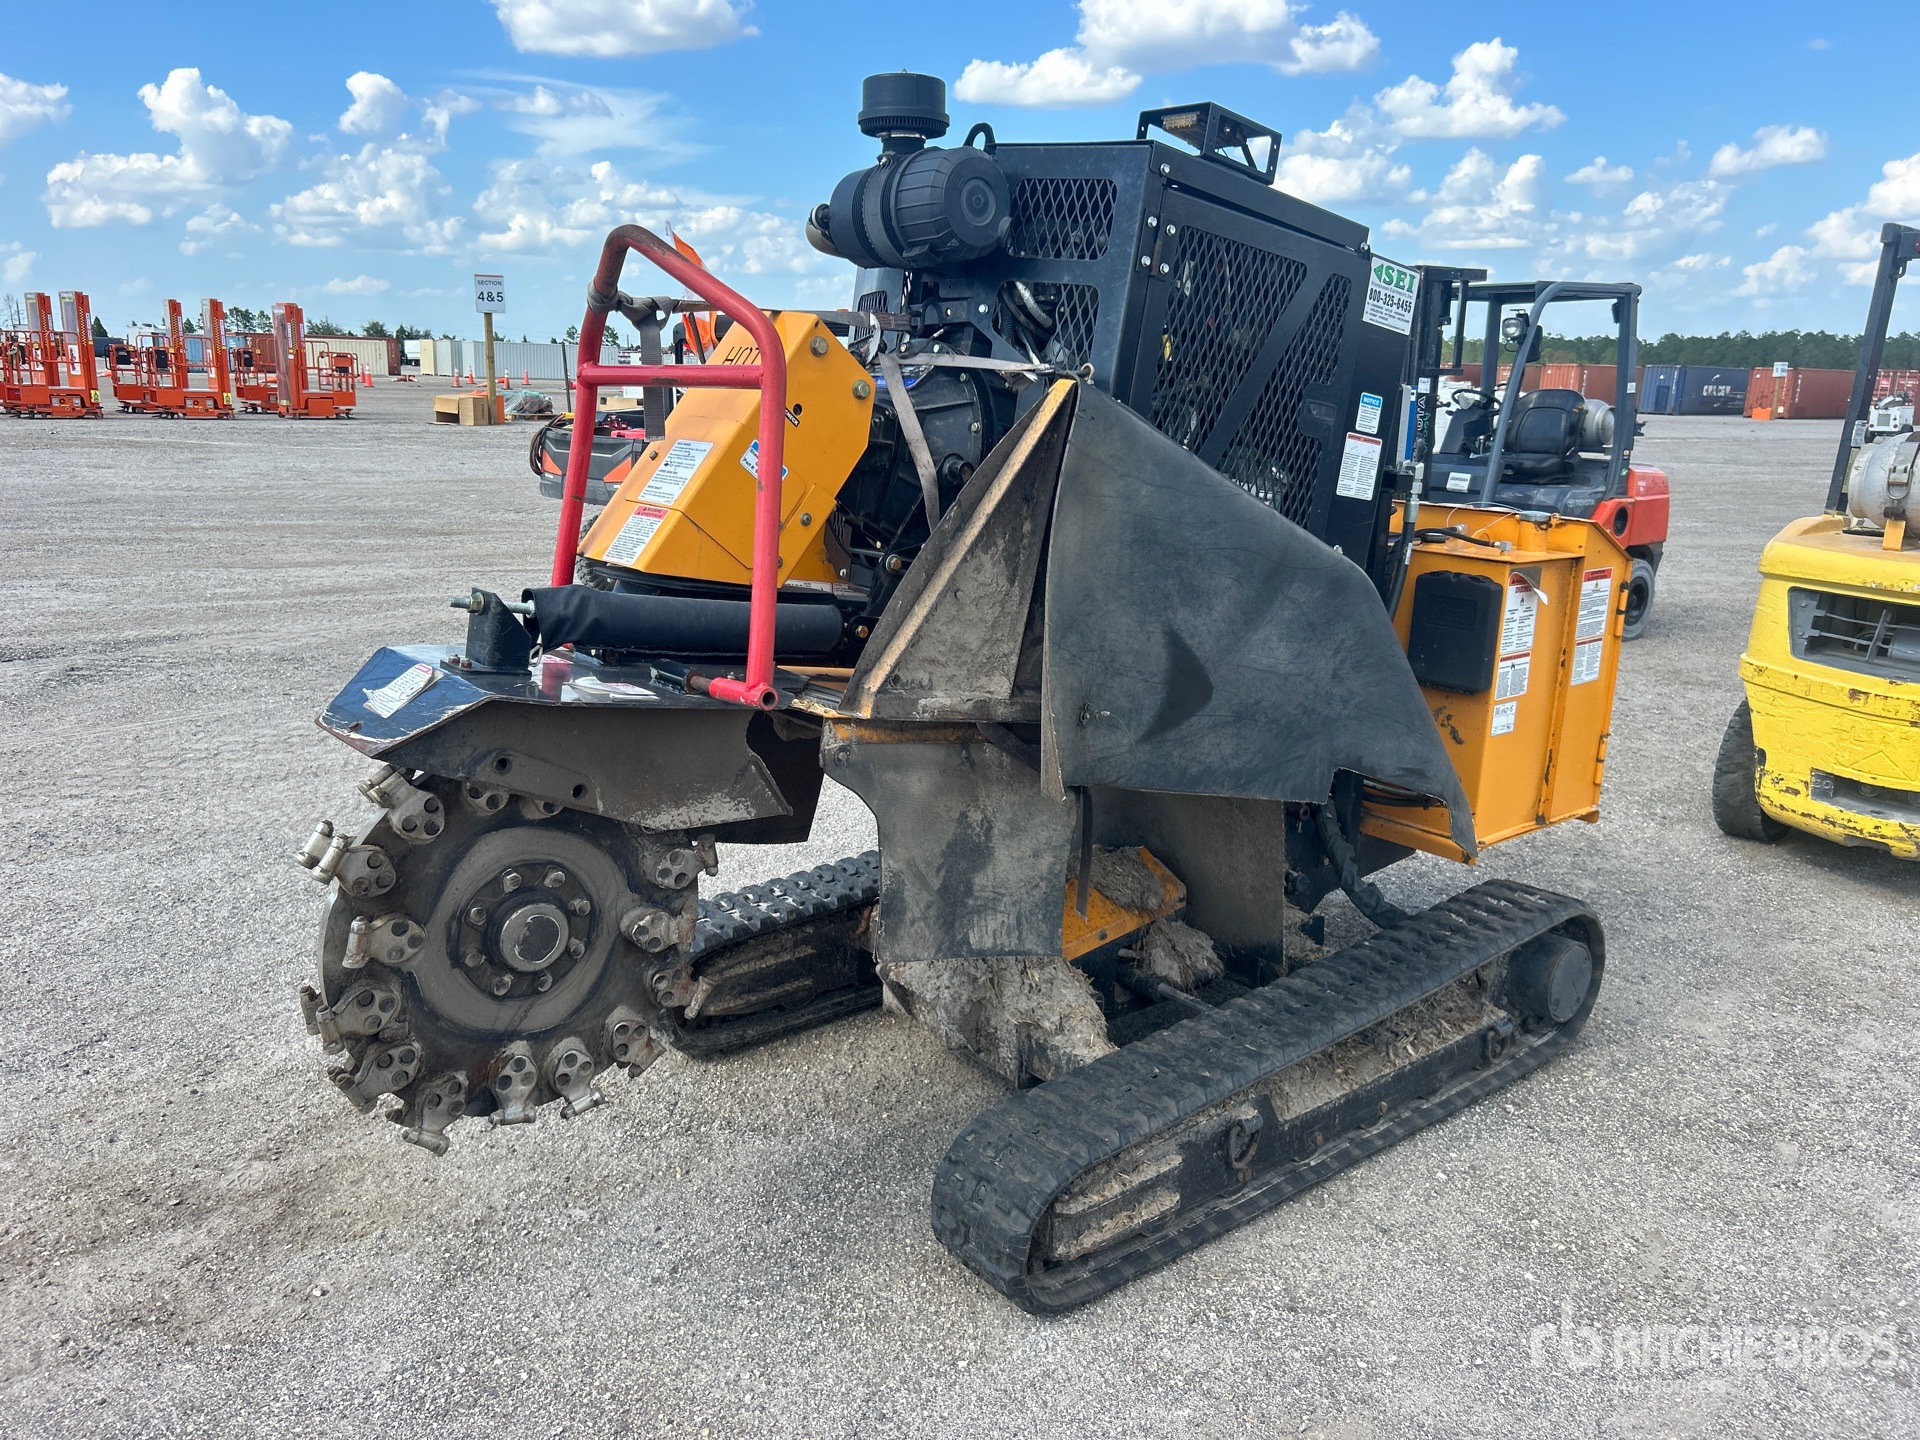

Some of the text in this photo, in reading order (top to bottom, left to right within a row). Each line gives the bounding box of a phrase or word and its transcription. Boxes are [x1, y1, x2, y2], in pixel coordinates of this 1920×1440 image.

[1383, 265, 1416, 293] SEI
[477, 291, 504, 302] 4&5
[1369, 288, 1412, 314] 800-325-6455
